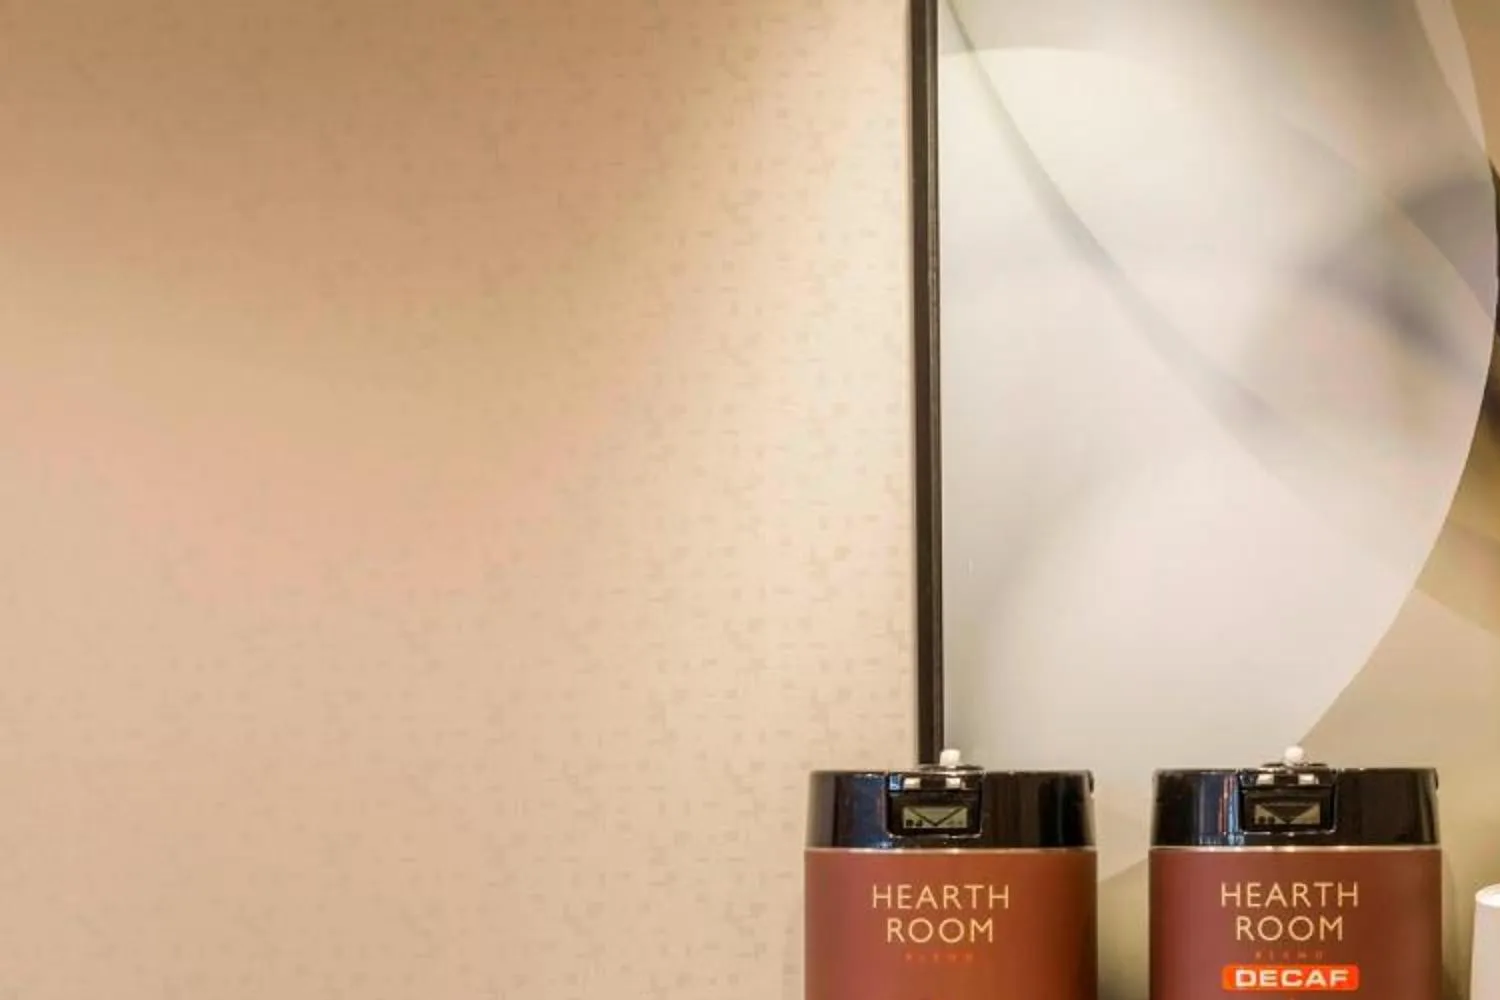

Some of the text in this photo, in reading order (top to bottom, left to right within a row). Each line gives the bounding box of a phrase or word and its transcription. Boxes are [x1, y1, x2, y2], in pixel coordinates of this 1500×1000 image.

[872, 884, 1010, 910] HEARTH
[1220, 881, 1359, 908] HEARTH
[886, 917, 994, 943] ROOM
[1236, 915, 1343, 941] ROOM
[1235, 968, 1350, 988] DECAF
